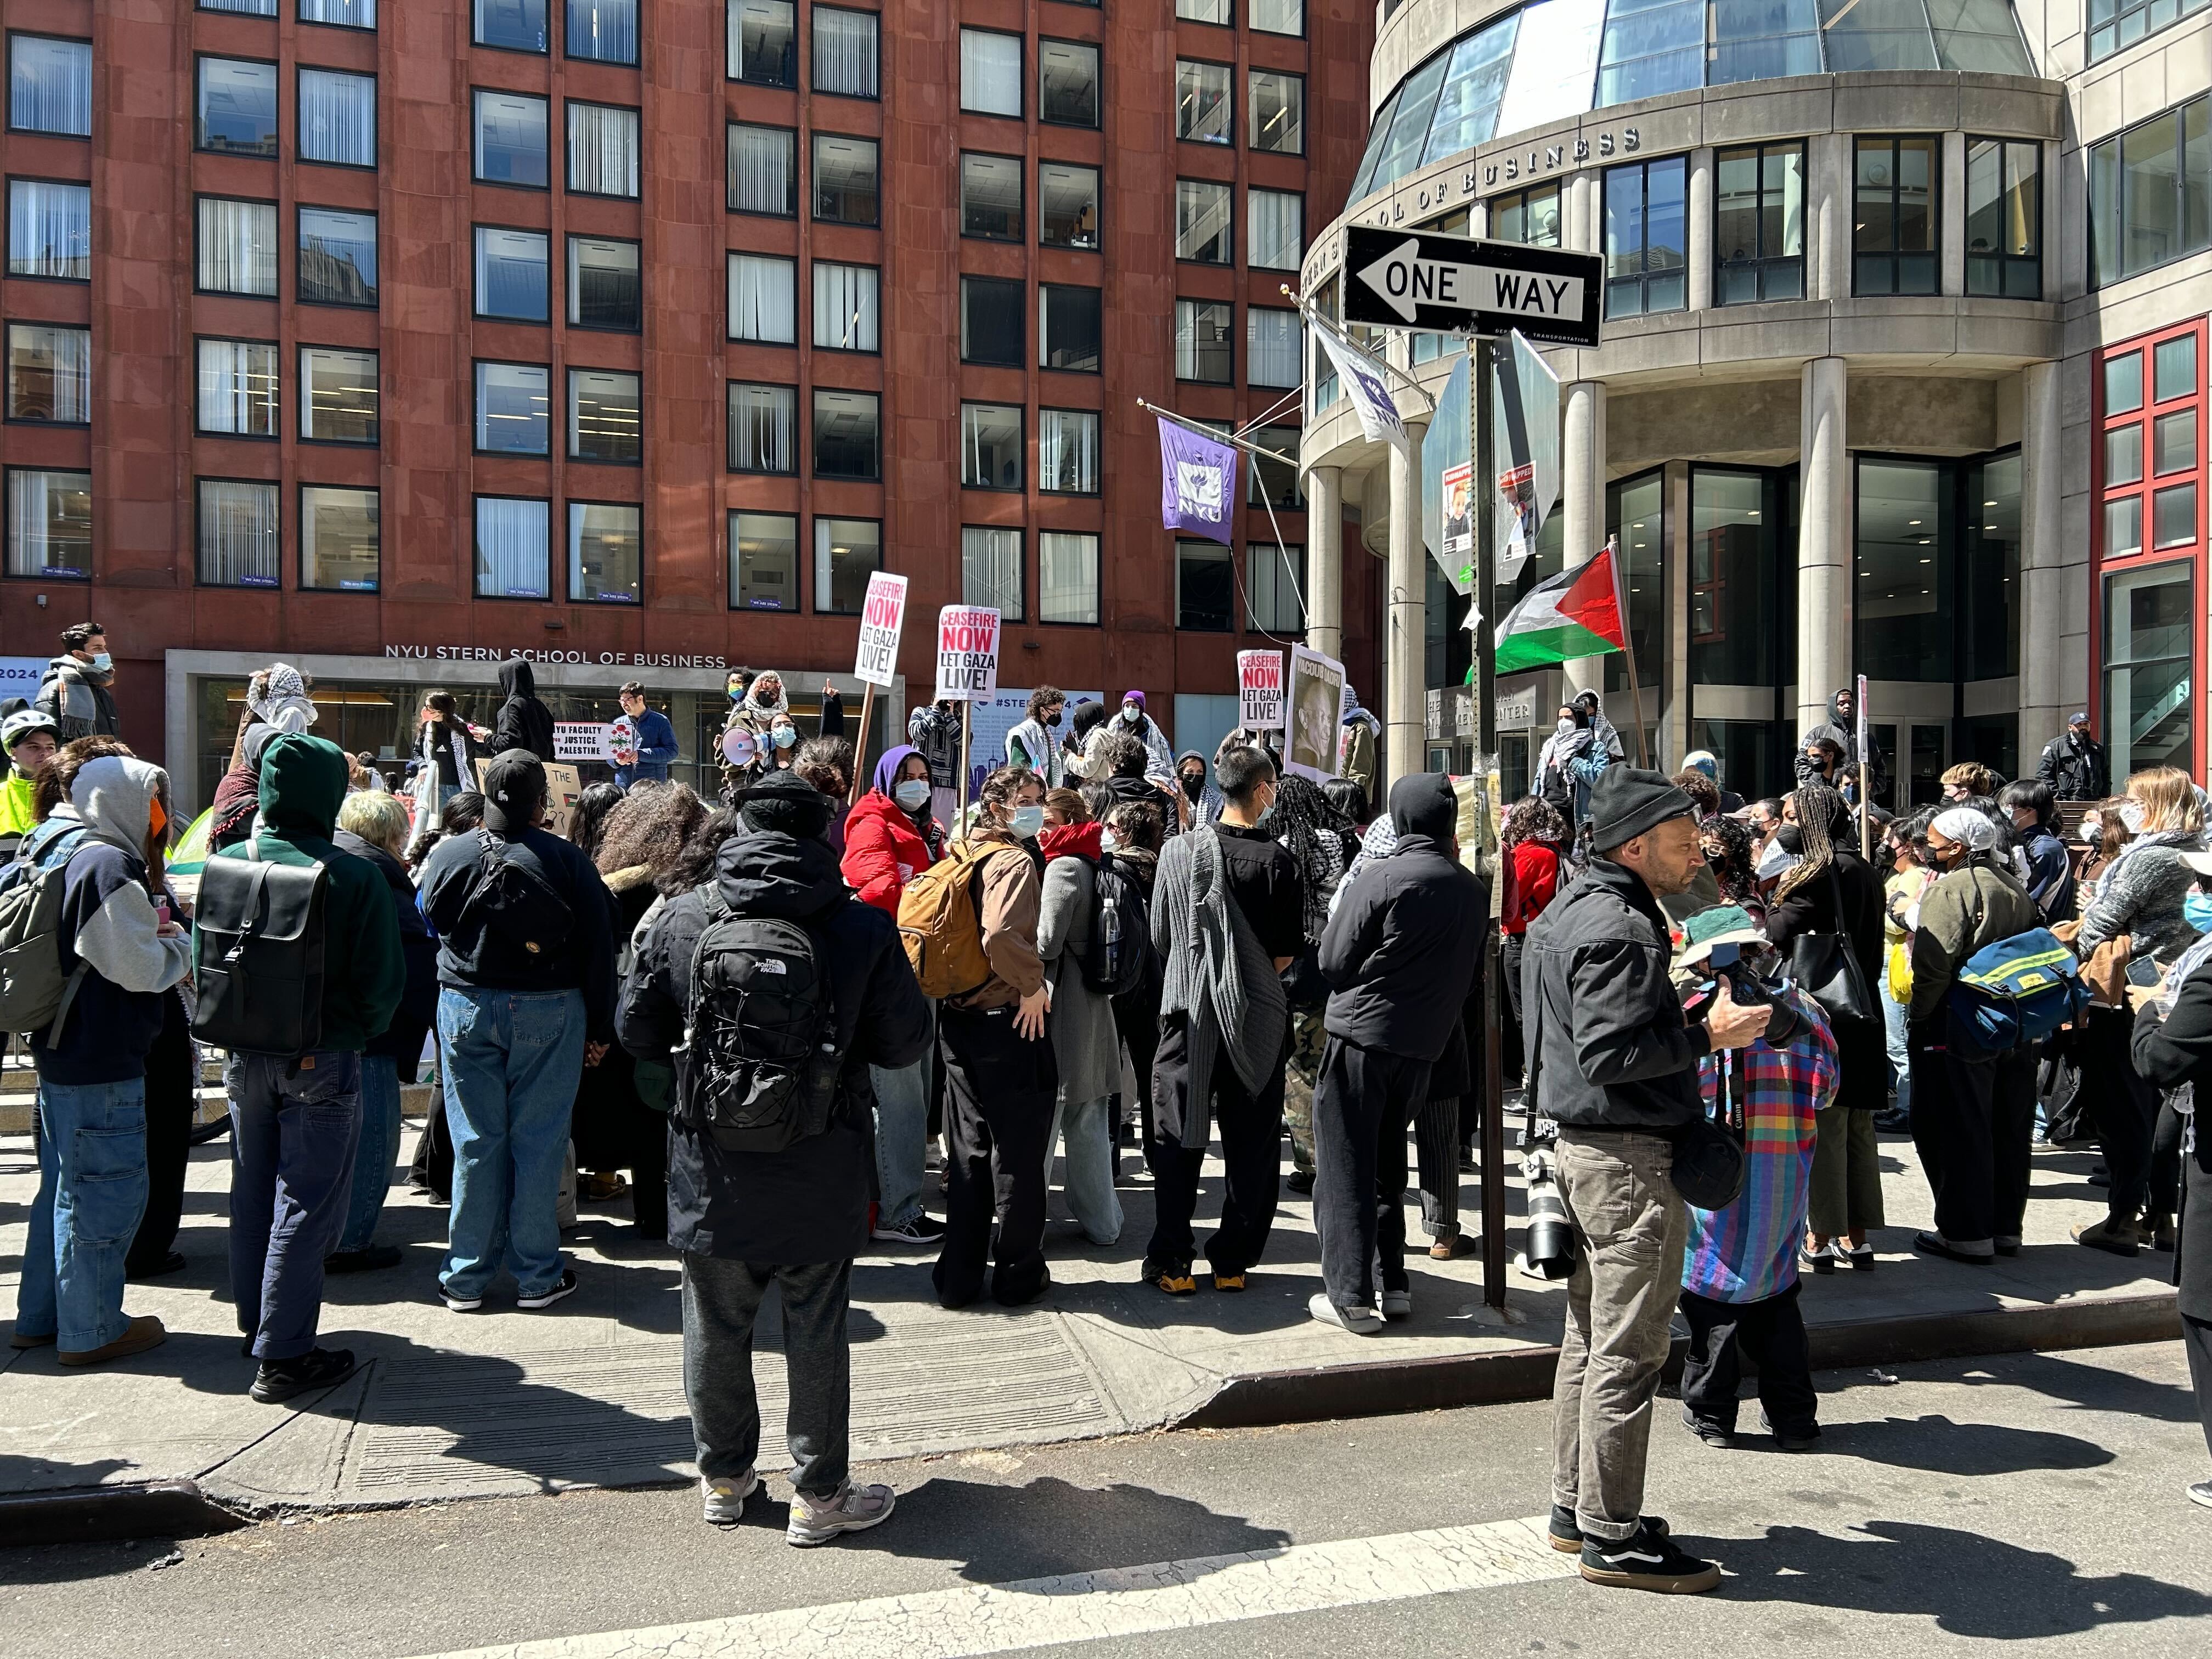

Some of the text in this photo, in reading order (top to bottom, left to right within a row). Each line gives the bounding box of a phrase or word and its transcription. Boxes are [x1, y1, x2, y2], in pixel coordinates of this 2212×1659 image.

[1417, 182, 1448, 211] OF
[1461, 127, 1640, 196] BUSINESS
[1386, 261, 1570, 315] ONE WAY
[1533, 332, 1589, 343] TRANSPORTATION
[1373, 406, 1408, 442] NYU
[1178, 498, 1222, 523] NYU
[869, 579, 905, 600] CEASEFIRE
[866, 597, 900, 629] NOW
[941, 612, 997, 629] CEASEFIRE
[862, 625, 896, 648] LET GAZA
[942, 627, 994, 653] NOW
[386, 645, 726, 669] NYU STERN SCHOOL OF BUSINESS
[862, 644, 891, 673] LIVE!
[941, 653, 995, 670] LET GAZA
[1240, 655, 1281, 668] CEASEFIRE
[0, 669, 37, 679] 2024
[1243, 668, 1279, 689] NOW
[1297, 657, 1324, 679] YACOUB
[945, 668, 988, 691] LIVE!
[1243, 689, 1282, 702] LET GAZA
[1246, 702, 1276, 720] LIVE!
[565, 736, 596, 744] JUSTICE
[559, 747, 601, 755] PALESTINE
[551, 770, 571, 783] THE
[1735, 1103, 1743, 1129] Canon
